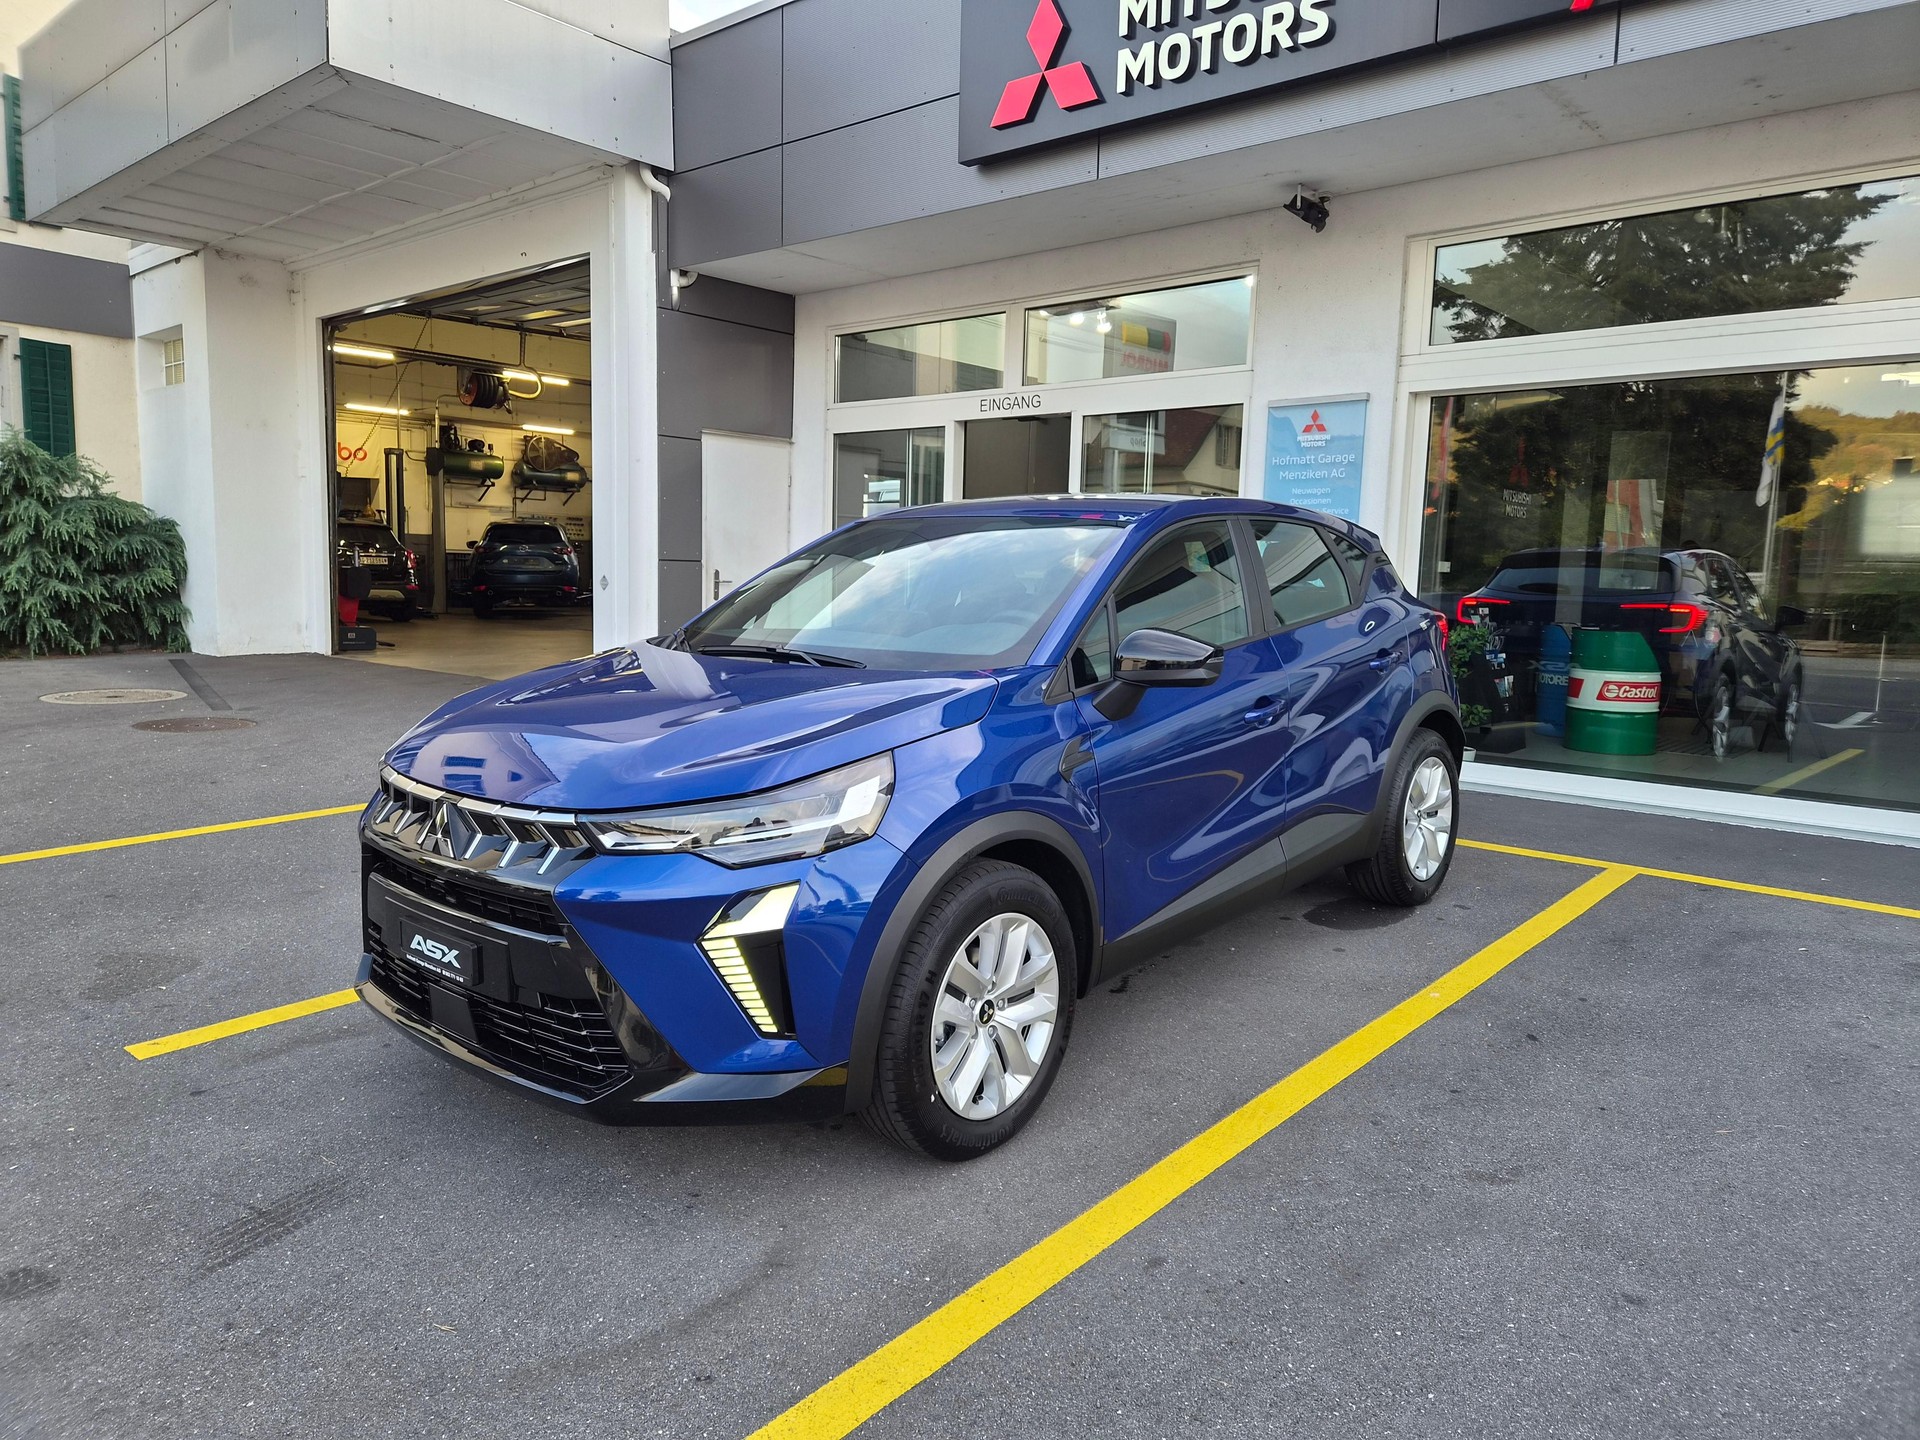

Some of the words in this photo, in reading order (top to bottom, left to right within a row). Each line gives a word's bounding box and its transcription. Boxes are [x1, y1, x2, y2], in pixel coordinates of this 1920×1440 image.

[1116, 0, 1332, 94] MOTORS
[979, 394, 1042, 413] EINGANG
[1297, 434, 1331, 442] MITSUBISHI
[1272, 455, 1315, 466] Hofmatt
[1318, 453, 1356, 465] Garage
[1279, 470, 1328, 480] Menziken
[1330, 468, 1346, 478] AG
[1292, 487, 1331, 496] Neuwagen
[1290, 497, 1332, 505] Occasionen
[1618, 685, 1658, 698] Castrol
[410, 934, 461, 969] ASX
